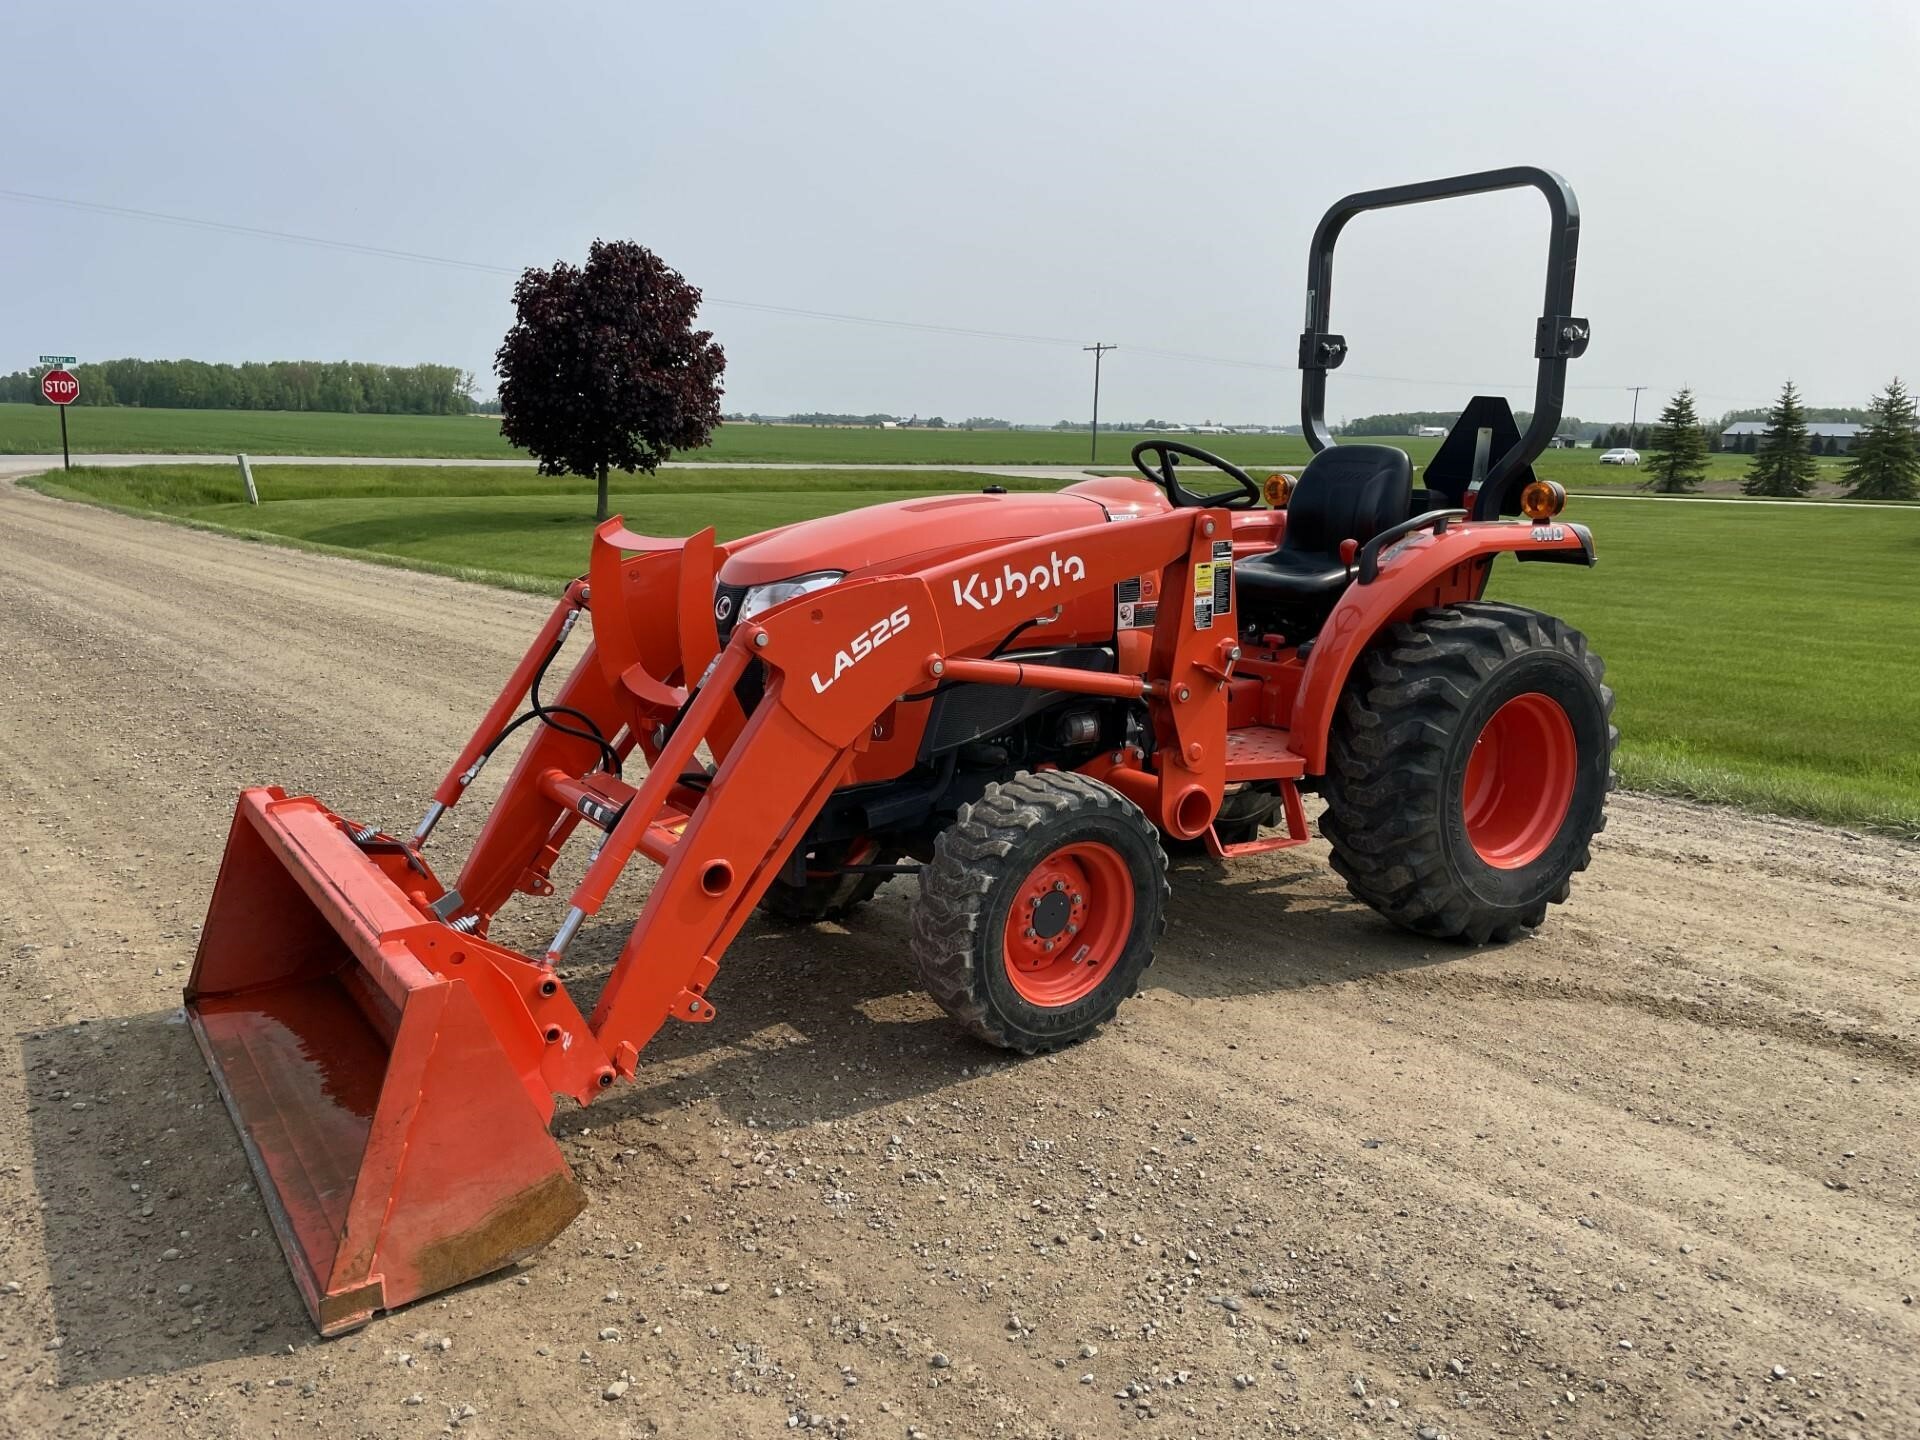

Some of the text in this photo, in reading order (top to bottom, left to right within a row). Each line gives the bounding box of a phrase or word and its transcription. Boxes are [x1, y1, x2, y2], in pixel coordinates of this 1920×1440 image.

[45, 380, 76, 393] STOP
[1531, 527, 1564, 542] 4WD
[953, 551, 1086, 610] Kubota
[810, 605, 912, 695] LA525
